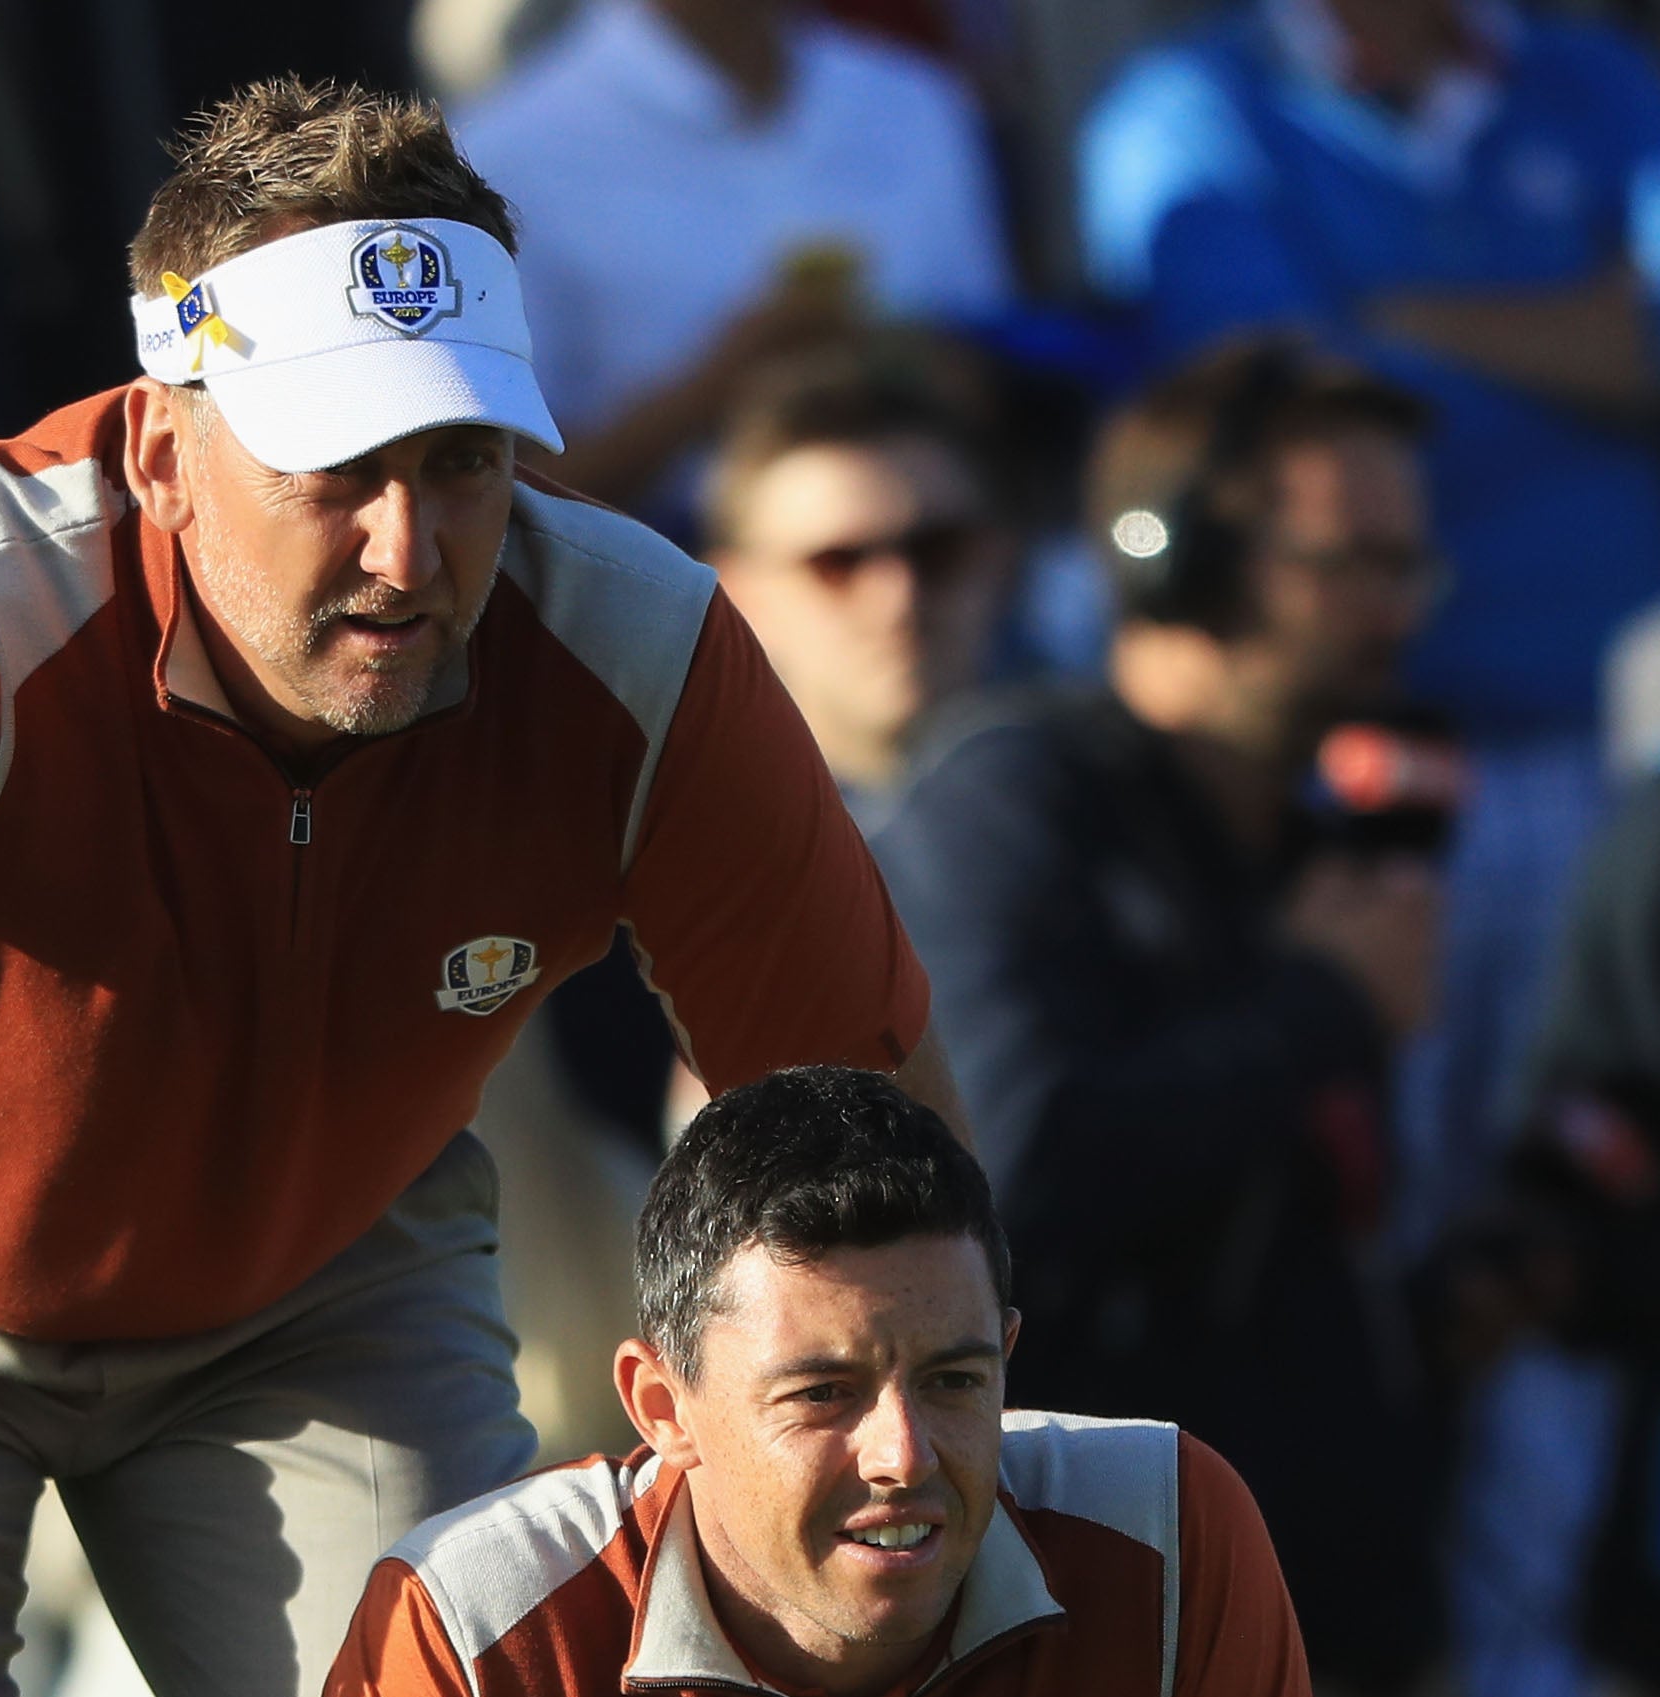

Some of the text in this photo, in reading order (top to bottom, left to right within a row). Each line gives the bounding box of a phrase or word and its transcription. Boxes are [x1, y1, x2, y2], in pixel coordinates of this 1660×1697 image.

[372, 290, 438, 305] EUROPE
[140, 328, 176, 352] UROPE
[457, 977, 522, 1001] EUROPE
